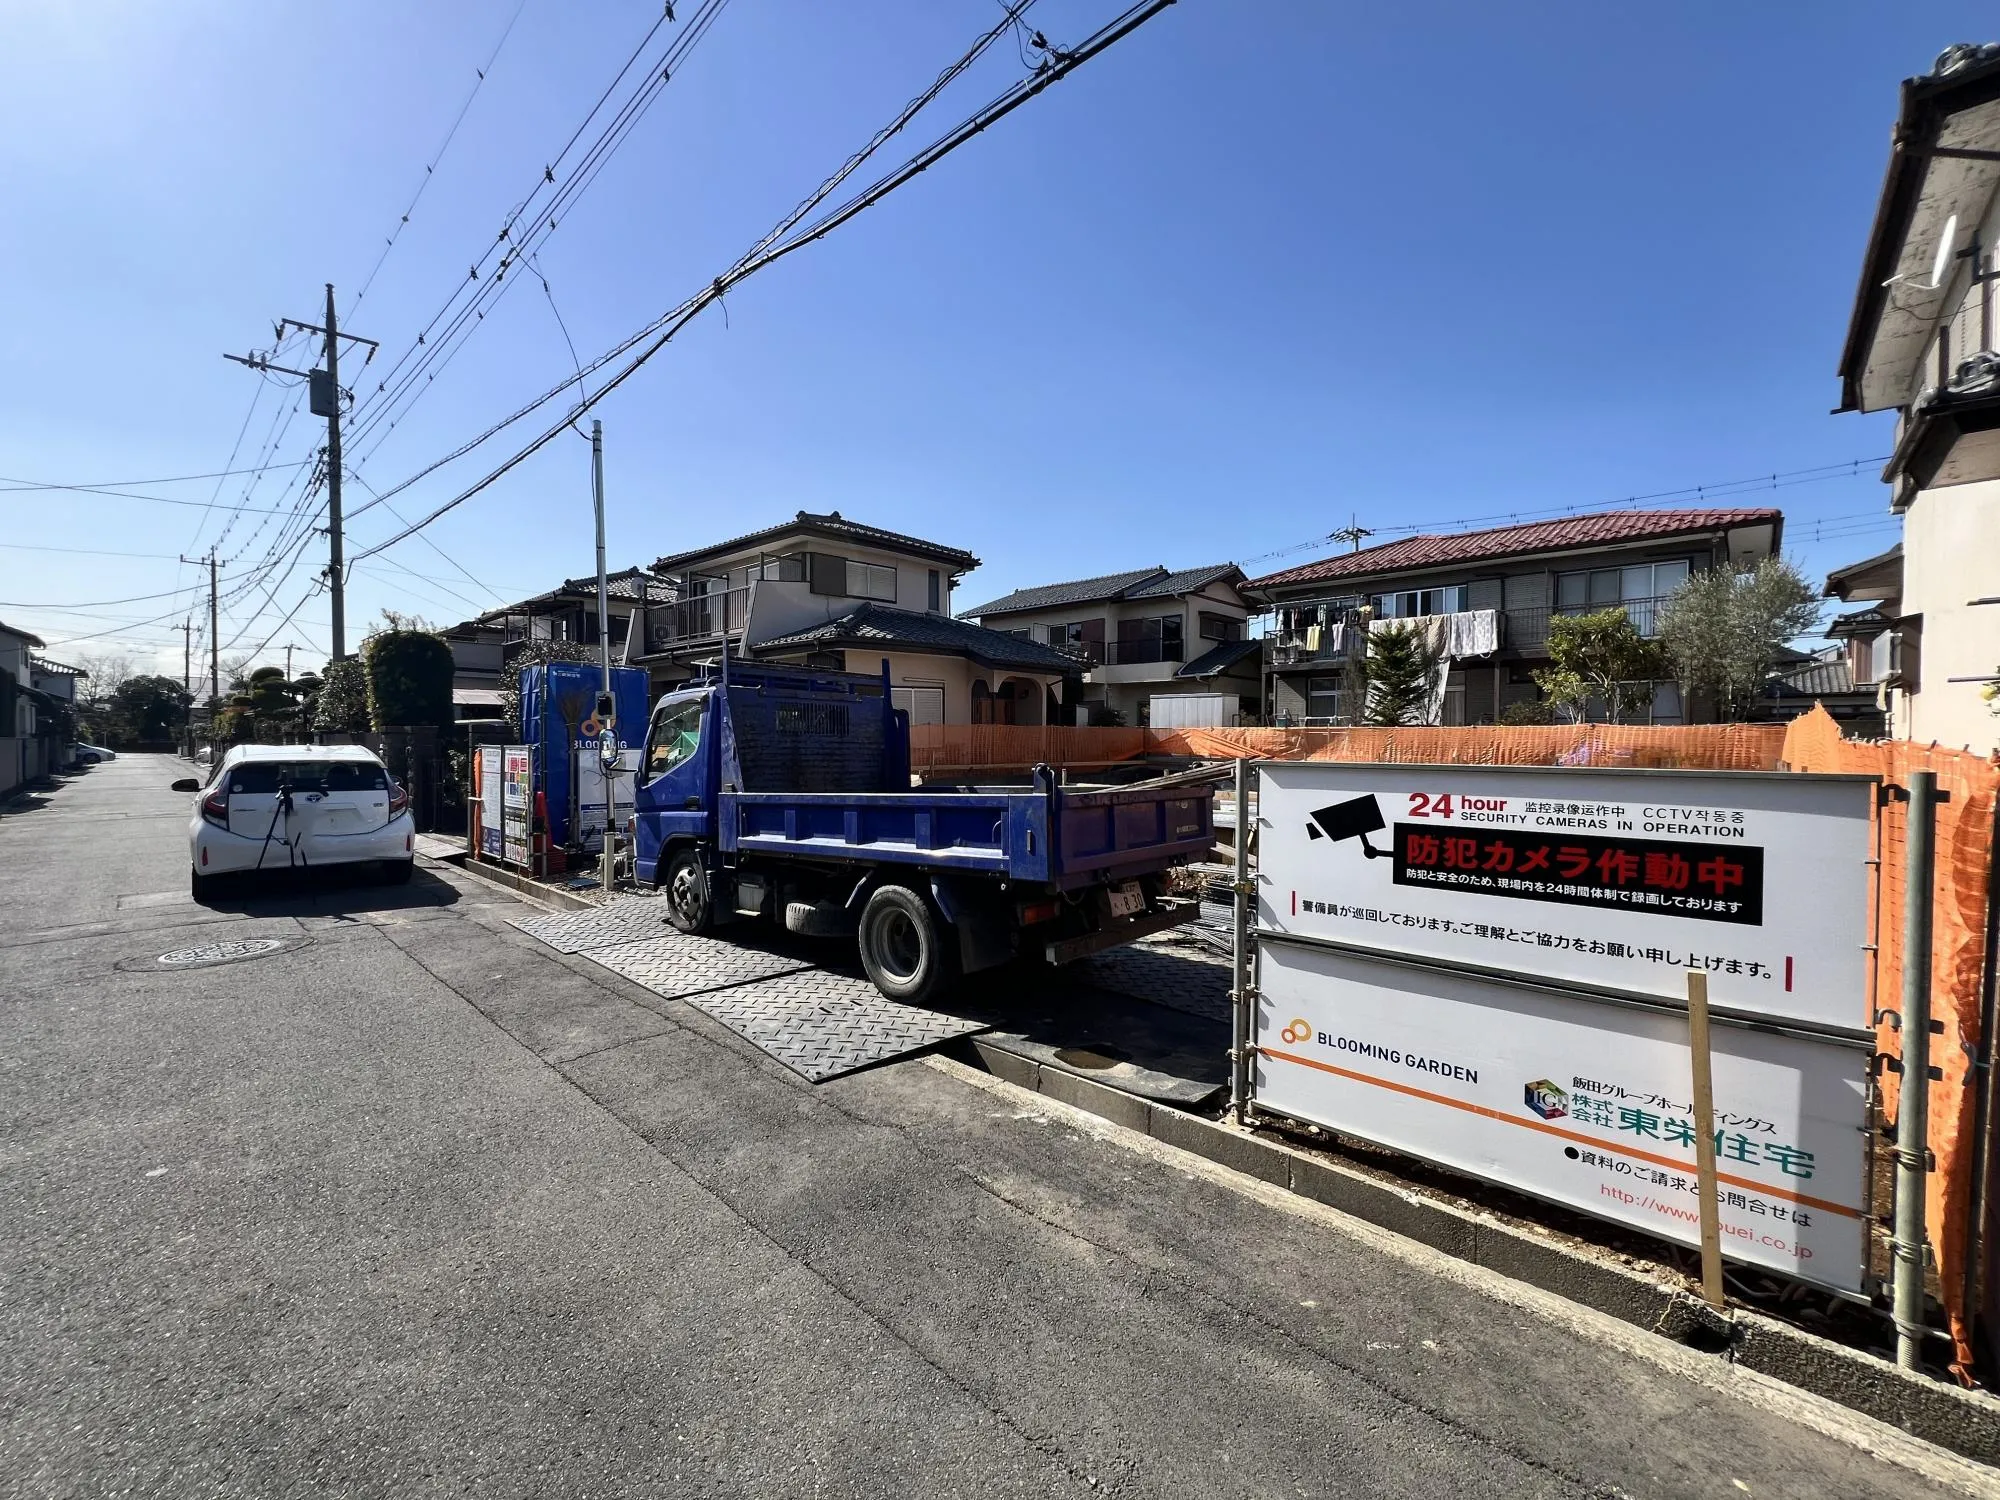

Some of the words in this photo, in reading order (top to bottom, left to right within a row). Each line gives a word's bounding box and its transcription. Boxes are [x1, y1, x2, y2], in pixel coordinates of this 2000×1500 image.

[573, 739, 628, 750] BLOOG
[1408, 792, 1454, 819] 24
[1461, 795, 1508, 812] hour
[1525, 801, 1625, 818] 监控录像运作中
[1461, 811, 1528, 824] SECURITY
[1536, 816, 1608, 829] CAMERAS
[1617, 820, 1633, 831] IN
[1643, 822, 1745, 838] OPERATION
[1407, 834, 1744, 895] 防犯カメラ作動中
[1406, 868, 1743, 914] 防犯と安全のため、現場内を24時間体制で録画しております
[1317, 1031, 1401, 1064] BLOOMING
[1405, 1053, 1479, 1085] GARDEN
[1617, 1106, 1816, 1180] 東栄住宅
